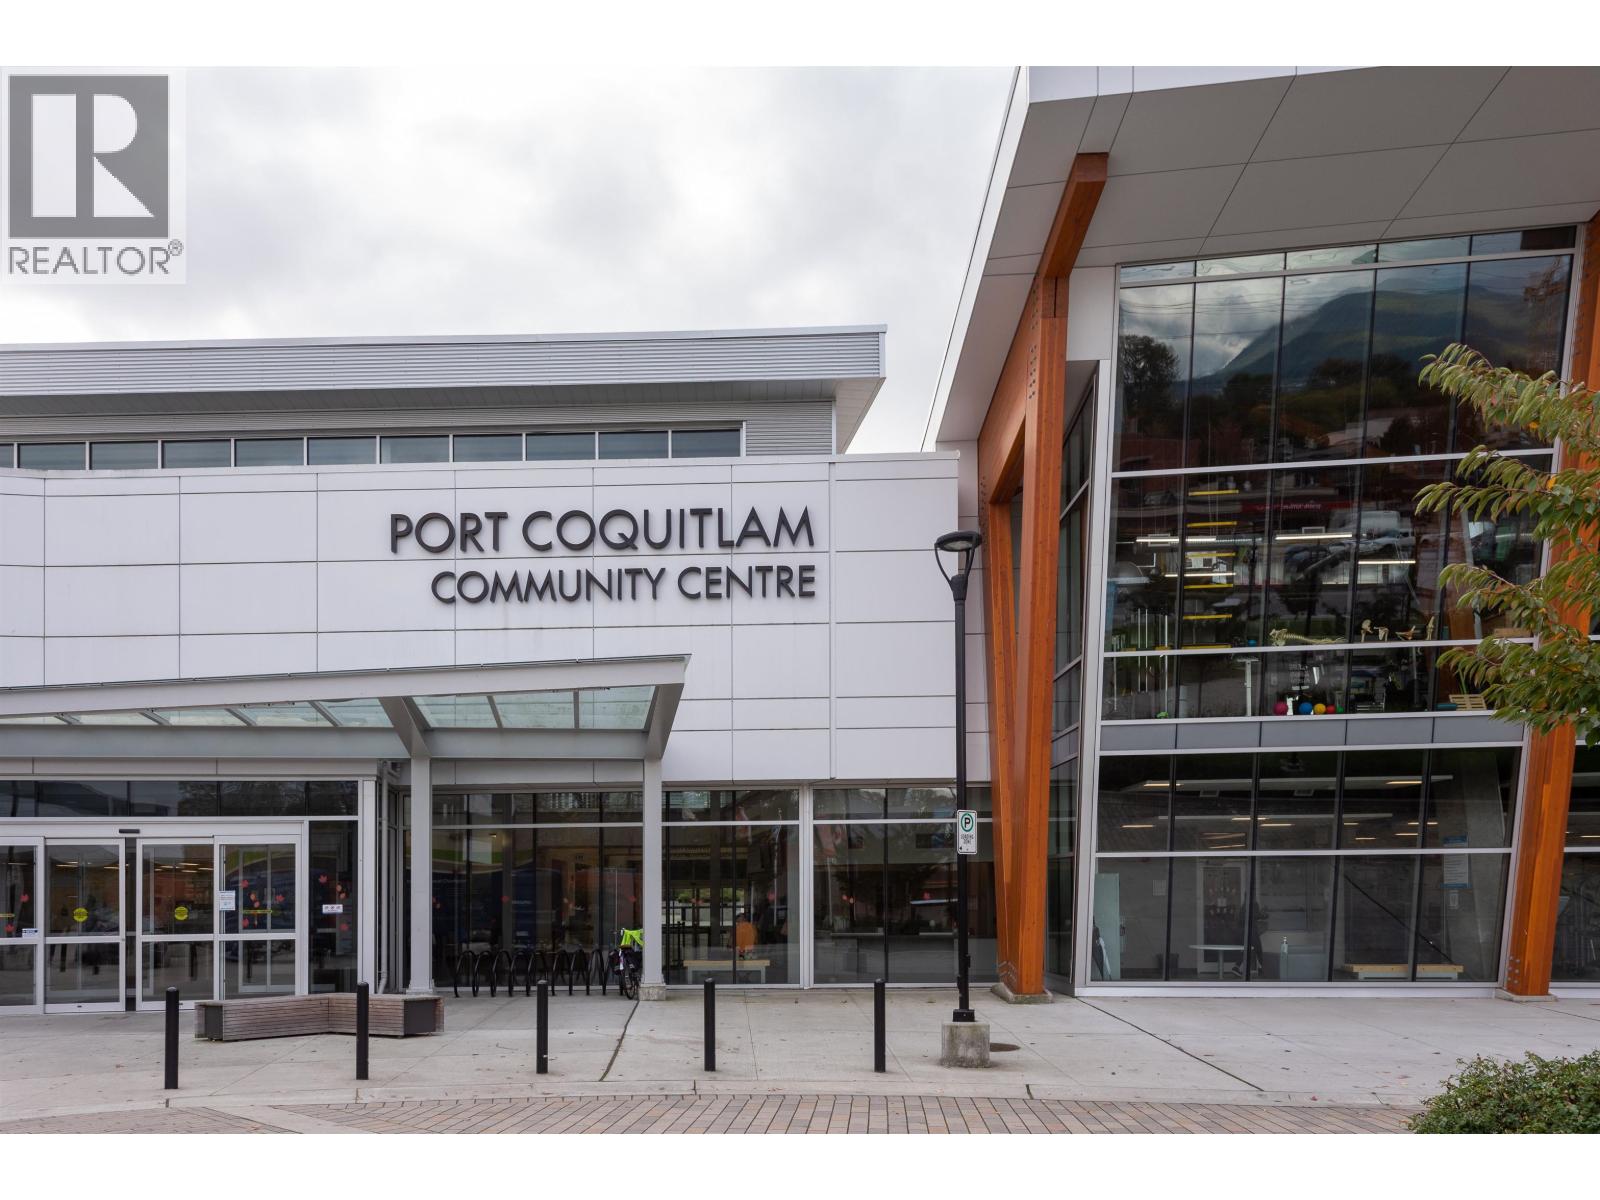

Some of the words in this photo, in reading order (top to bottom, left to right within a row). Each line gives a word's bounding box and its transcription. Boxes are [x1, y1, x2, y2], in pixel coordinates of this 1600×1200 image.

[391, 512, 508, 553] PORT
[522, 506, 815, 551] COQUITLAM
[431, 568, 666, 603] COMMUNITY
[677, 564, 816, 600] CENTRE
